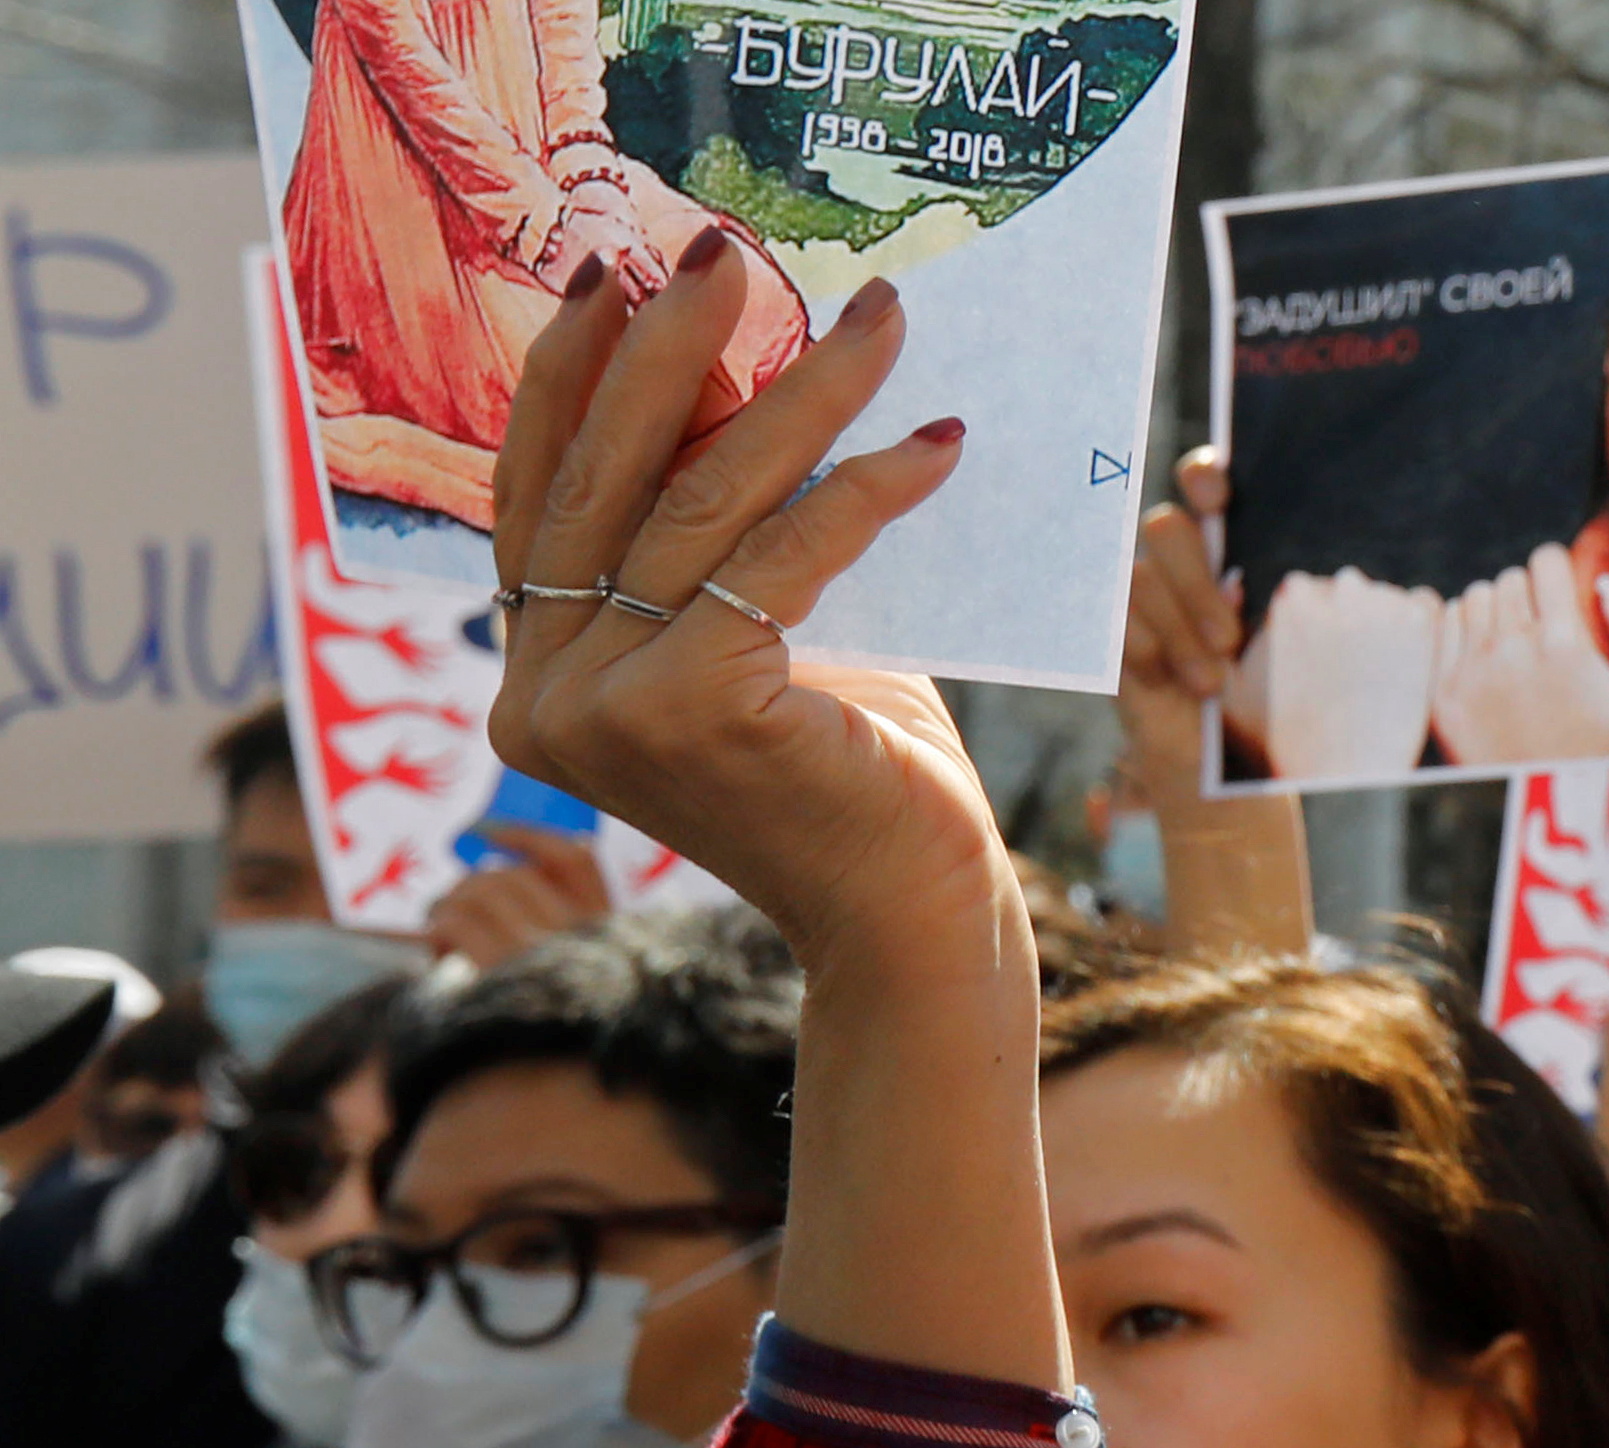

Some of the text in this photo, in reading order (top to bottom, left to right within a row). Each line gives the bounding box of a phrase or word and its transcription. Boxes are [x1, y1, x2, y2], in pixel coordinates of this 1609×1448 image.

[801, 112, 888, 157] 1998
[927, 128, 1006, 181] 2018
[1438, 254, 1575, 314] СВОЕЙ
